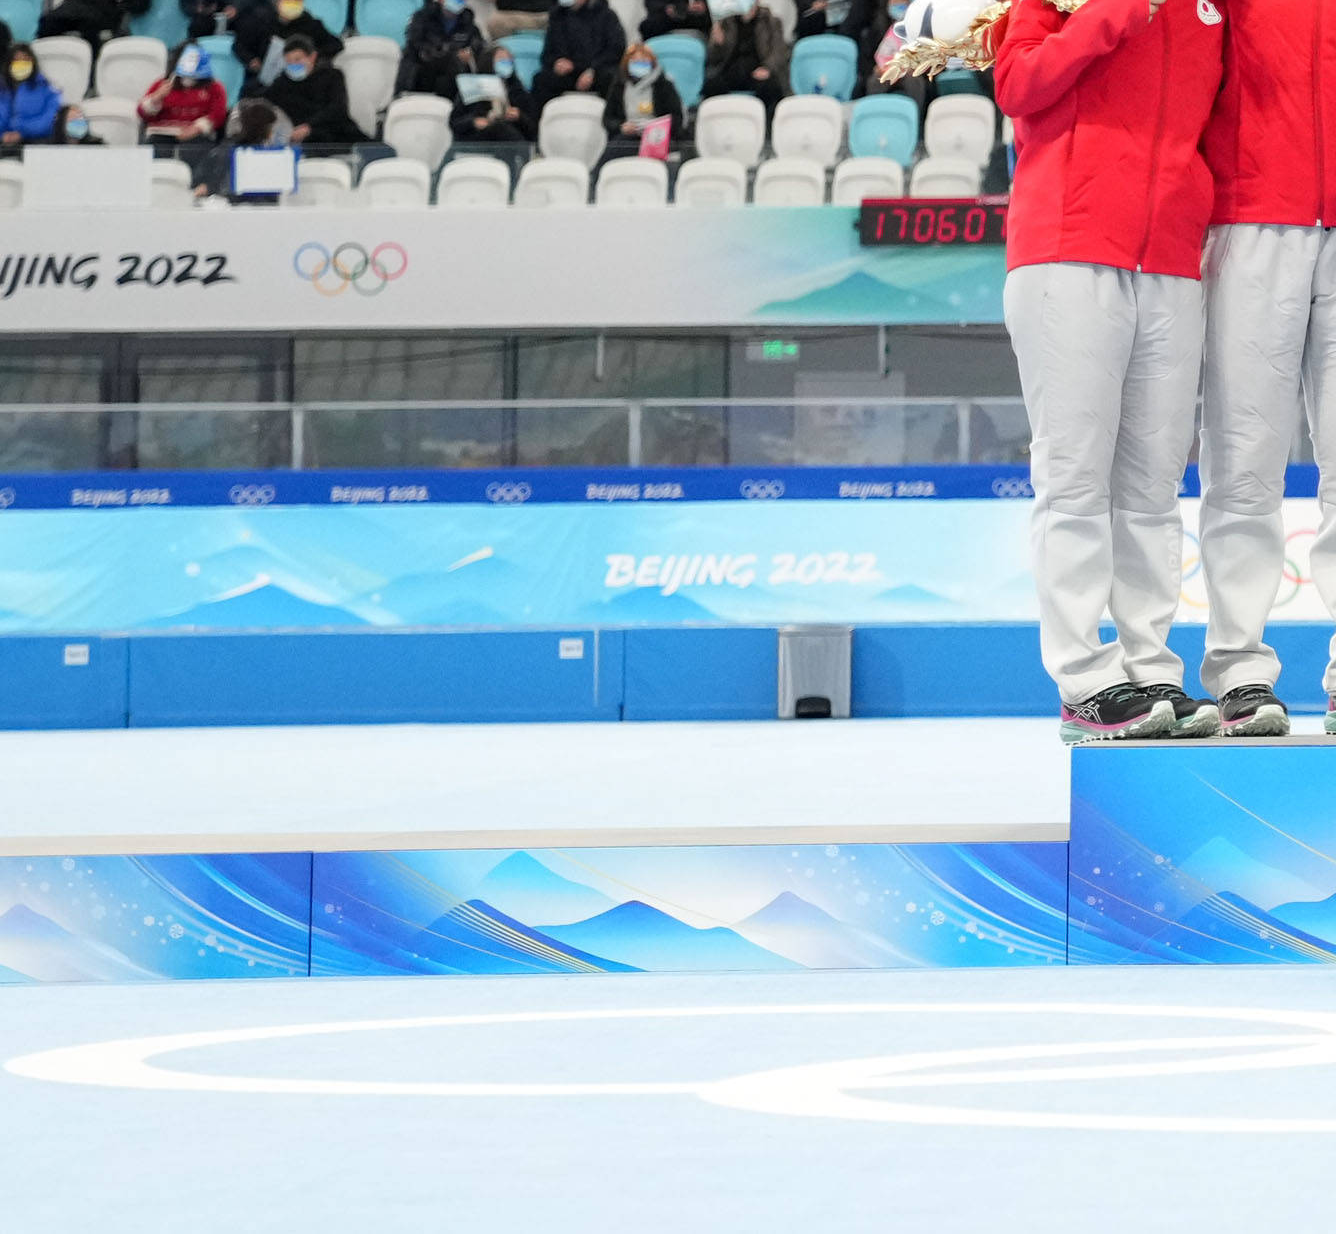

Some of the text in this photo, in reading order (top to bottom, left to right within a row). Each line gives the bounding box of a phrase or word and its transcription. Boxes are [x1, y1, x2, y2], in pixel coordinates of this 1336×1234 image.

[115, 253, 239, 288] 2022
[604, 552, 884, 597] BEIJING 2022
